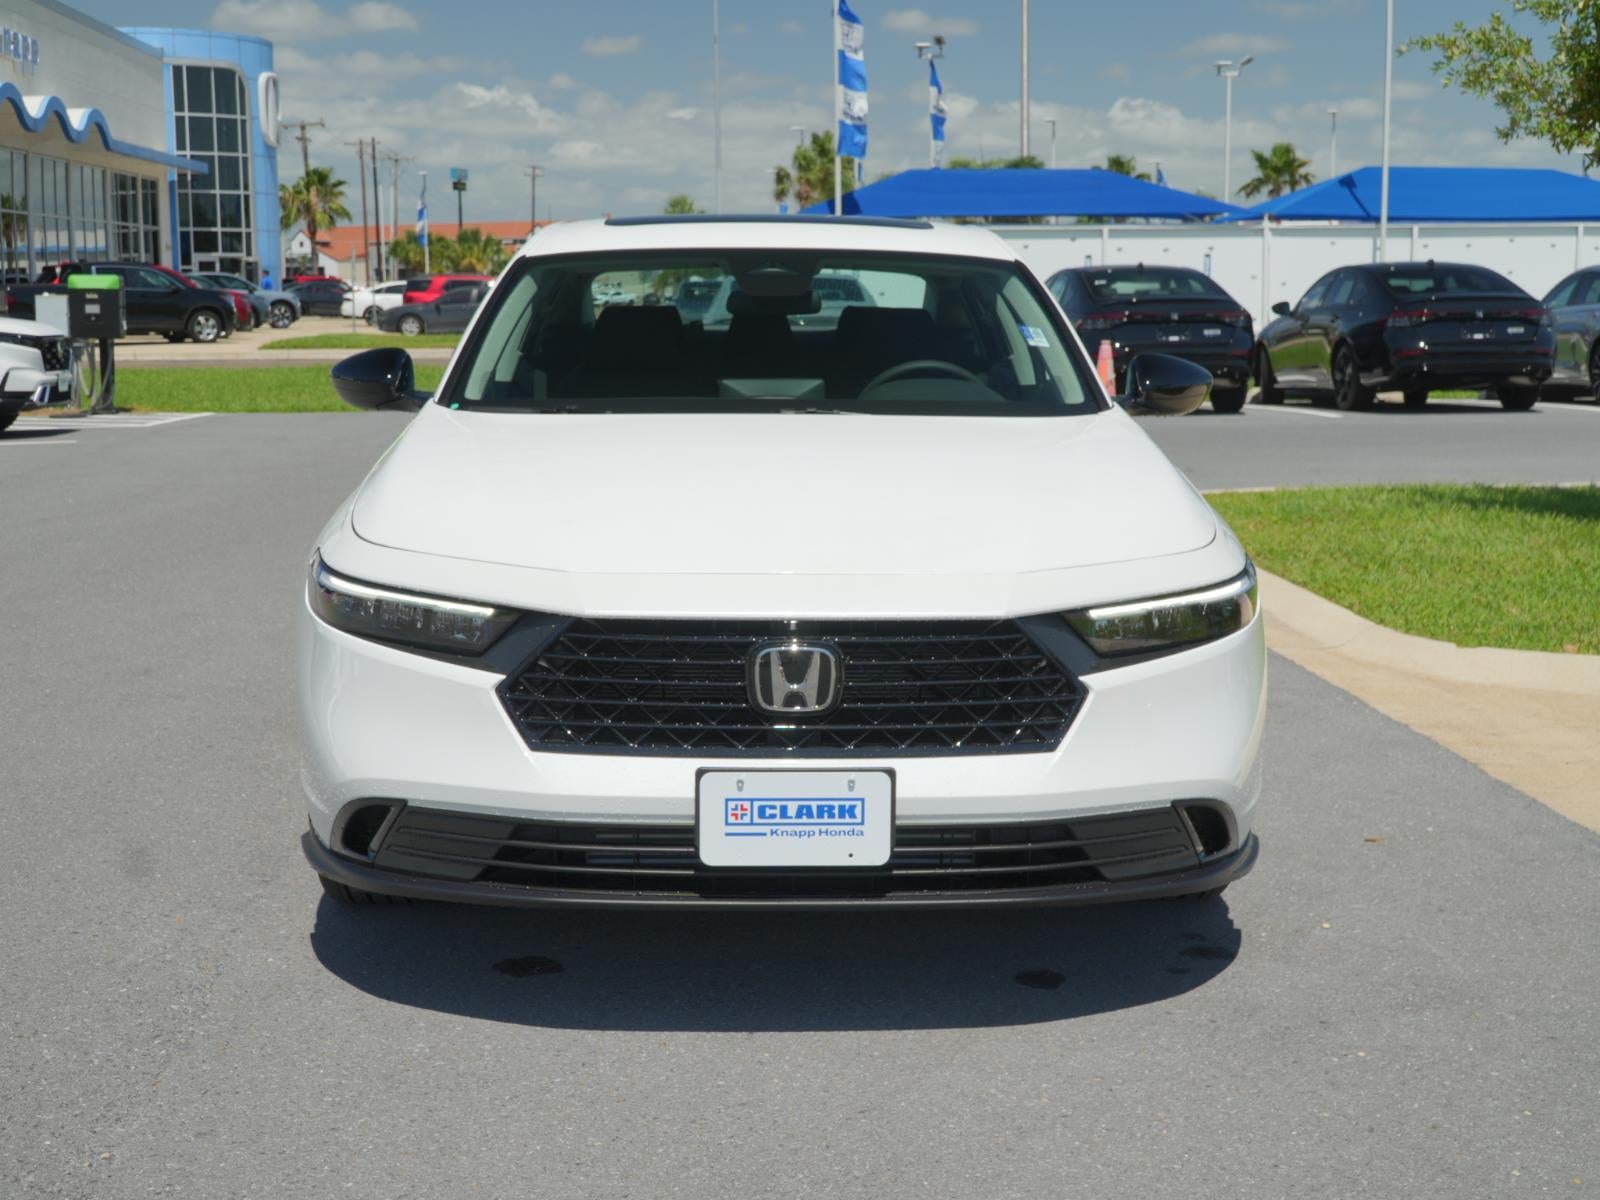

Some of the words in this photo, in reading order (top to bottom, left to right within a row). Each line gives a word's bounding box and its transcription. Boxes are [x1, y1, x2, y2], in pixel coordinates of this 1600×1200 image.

[0, 26, 40, 76] napp
[757, 804, 858, 820] CLARK
[769, 828, 816, 839] Knapp
[818, 827, 865, 838] Honda
